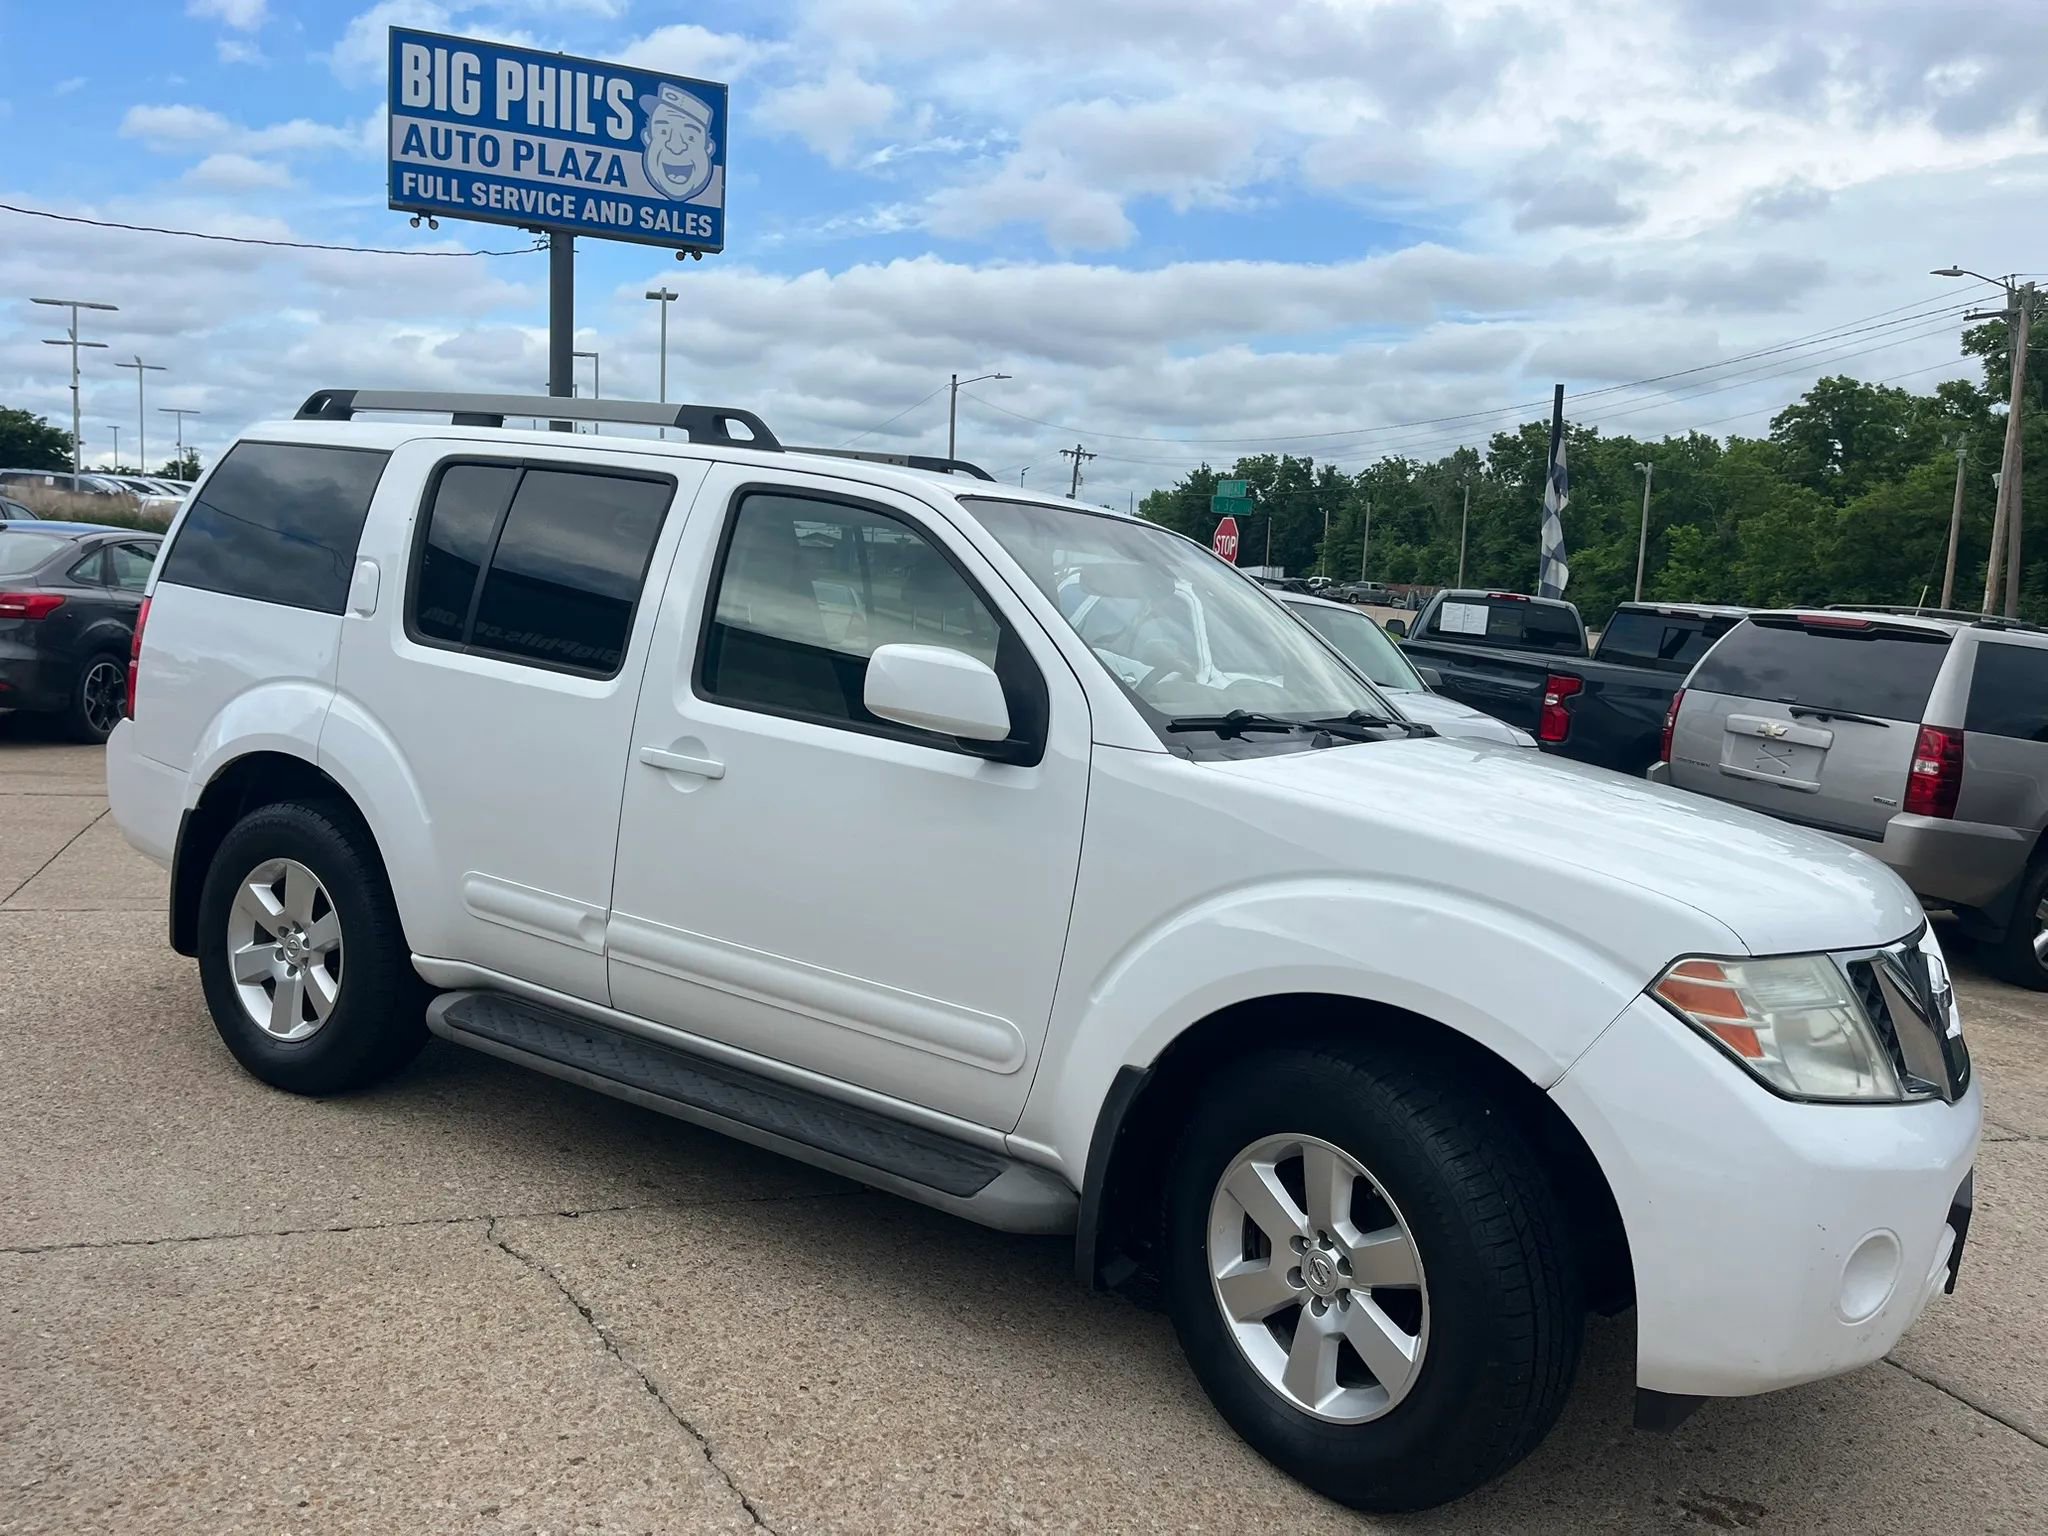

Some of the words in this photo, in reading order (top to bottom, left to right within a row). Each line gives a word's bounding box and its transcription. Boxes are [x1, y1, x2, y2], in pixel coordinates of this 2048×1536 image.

[402, 42, 481, 116] BIG
[496, 58, 633, 140] PHIL'S
[401, 123, 500, 168] AUTO
[512, 139, 628, 188] PLAZA
[403, 172, 464, 203] FULL
[471, 182, 576, 219] SERVICE
[582, 198, 634, 226] AND
[640, 208, 713, 238] SALES
[1215, 535, 1236, 556] STOP
